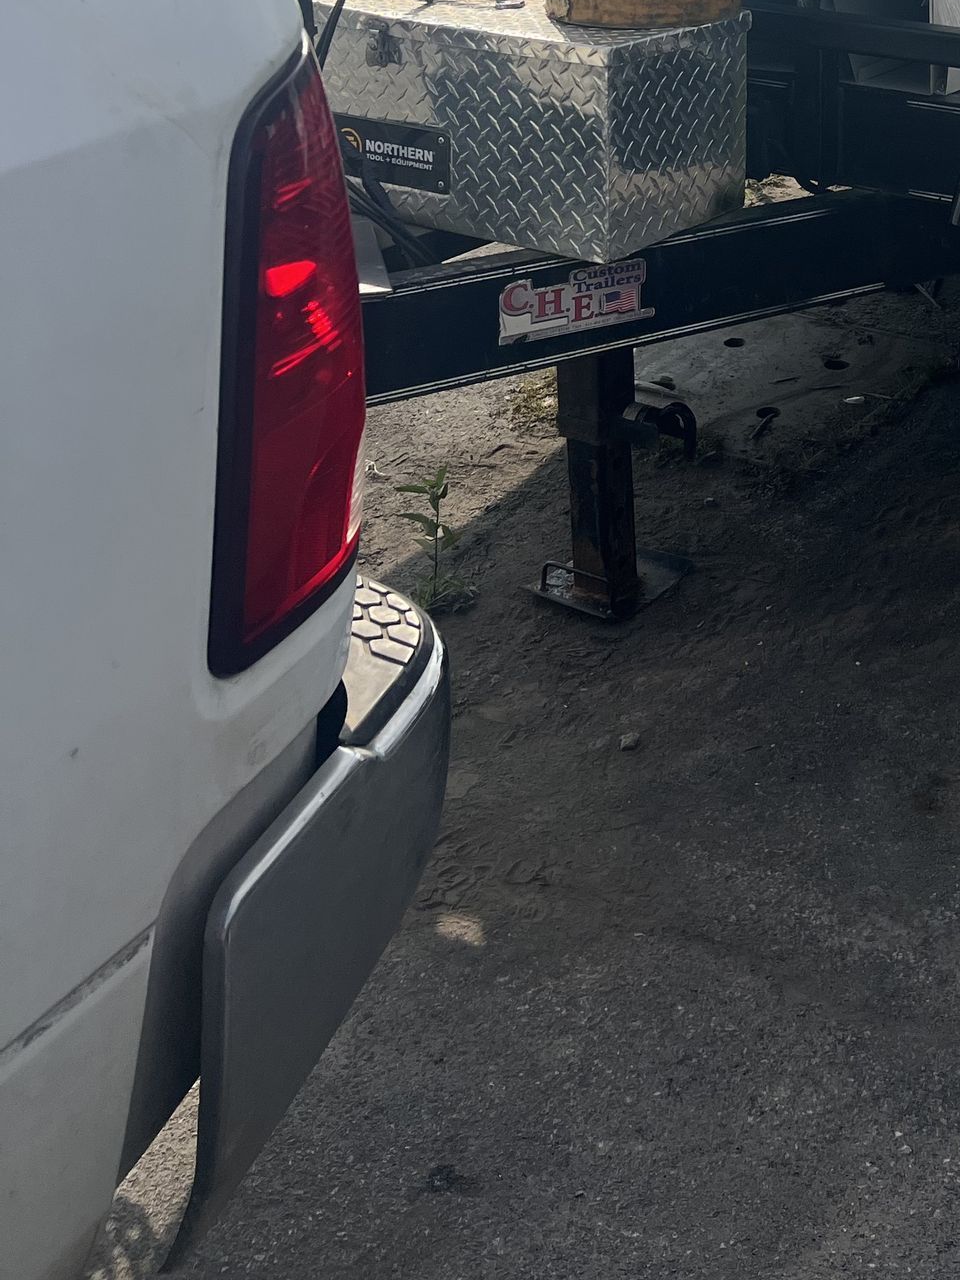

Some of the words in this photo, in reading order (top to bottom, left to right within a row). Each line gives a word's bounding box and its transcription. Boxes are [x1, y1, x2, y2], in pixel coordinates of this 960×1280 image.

[365, 139, 433, 162] NORTHERN
[366, 153, 384, 162] TOOL
[391, 158, 433, 171] EQUIPMENT
[572, 263, 641, 282] Custom
[573, 274, 641, 294] Trailers
